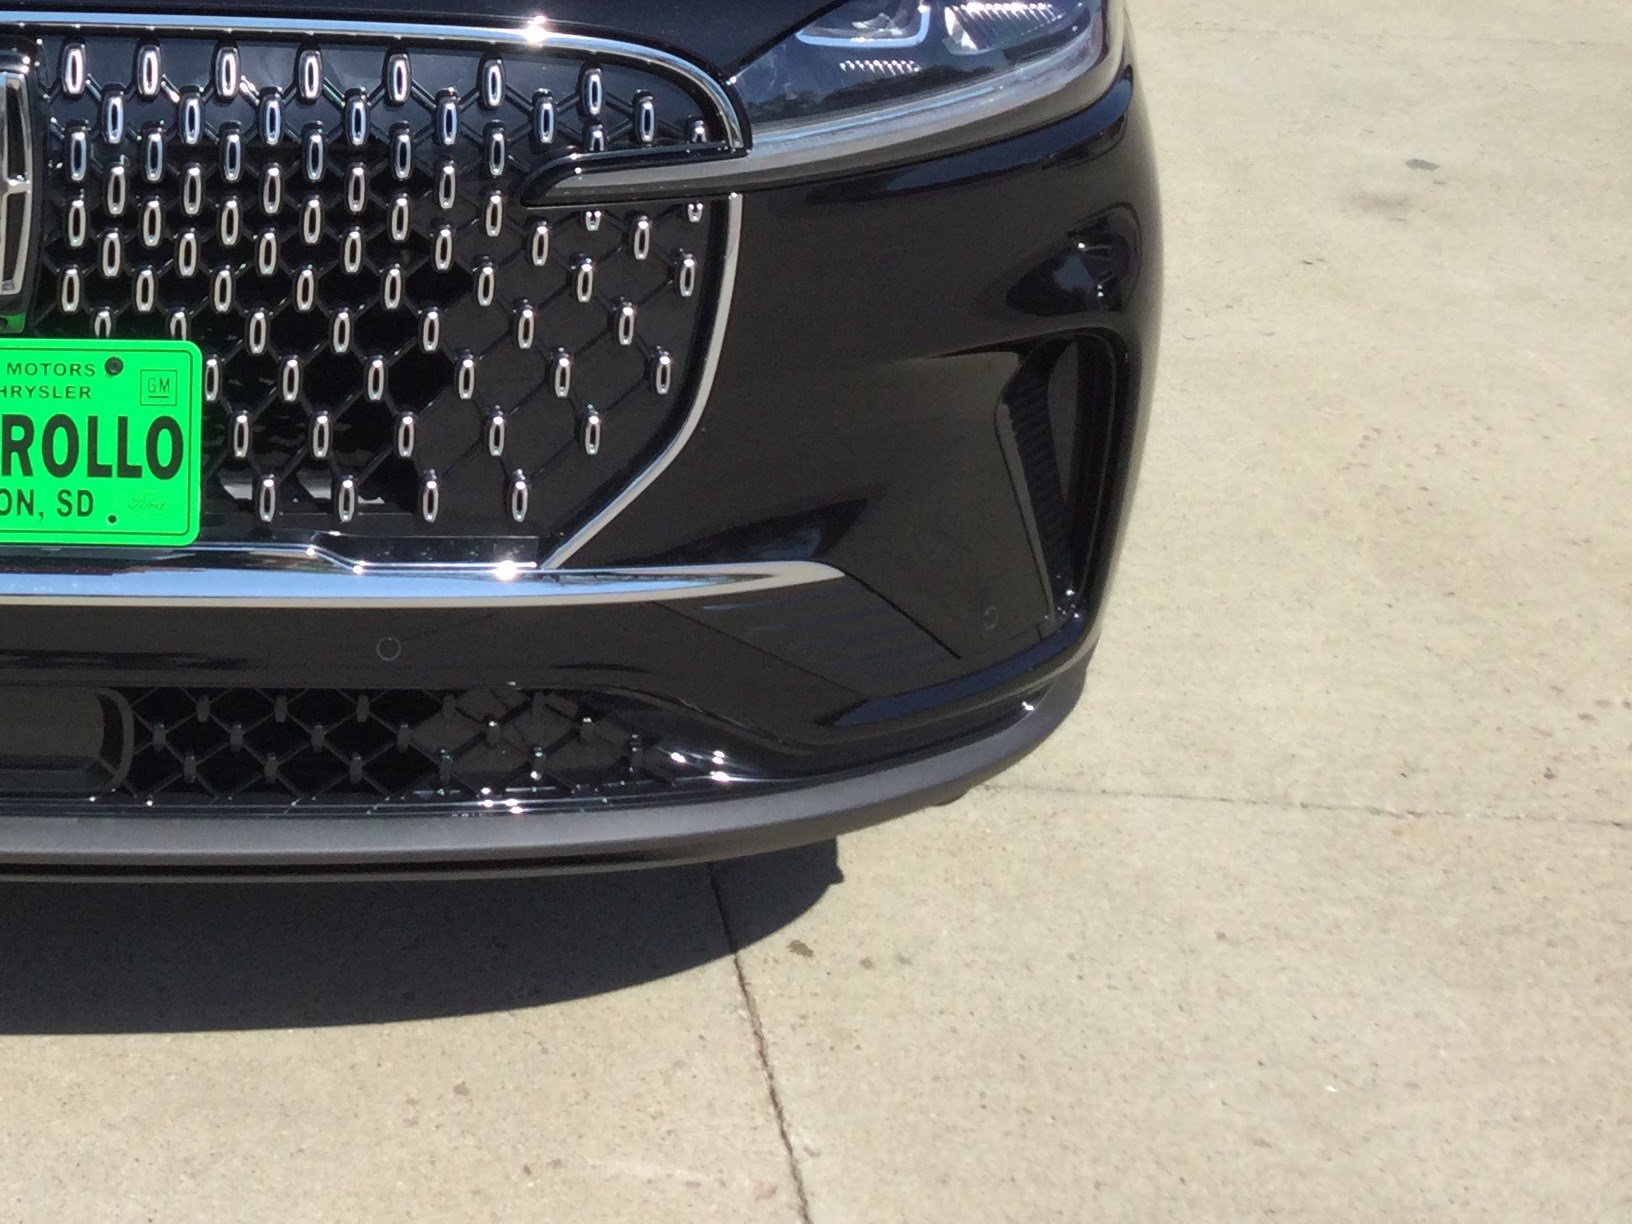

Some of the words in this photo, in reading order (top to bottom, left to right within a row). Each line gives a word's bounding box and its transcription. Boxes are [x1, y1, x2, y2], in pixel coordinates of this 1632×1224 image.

[6, 362, 96, 376] MOTORS
[147, 376, 171, 394] GM
[56, 489, 94, 517] SD
